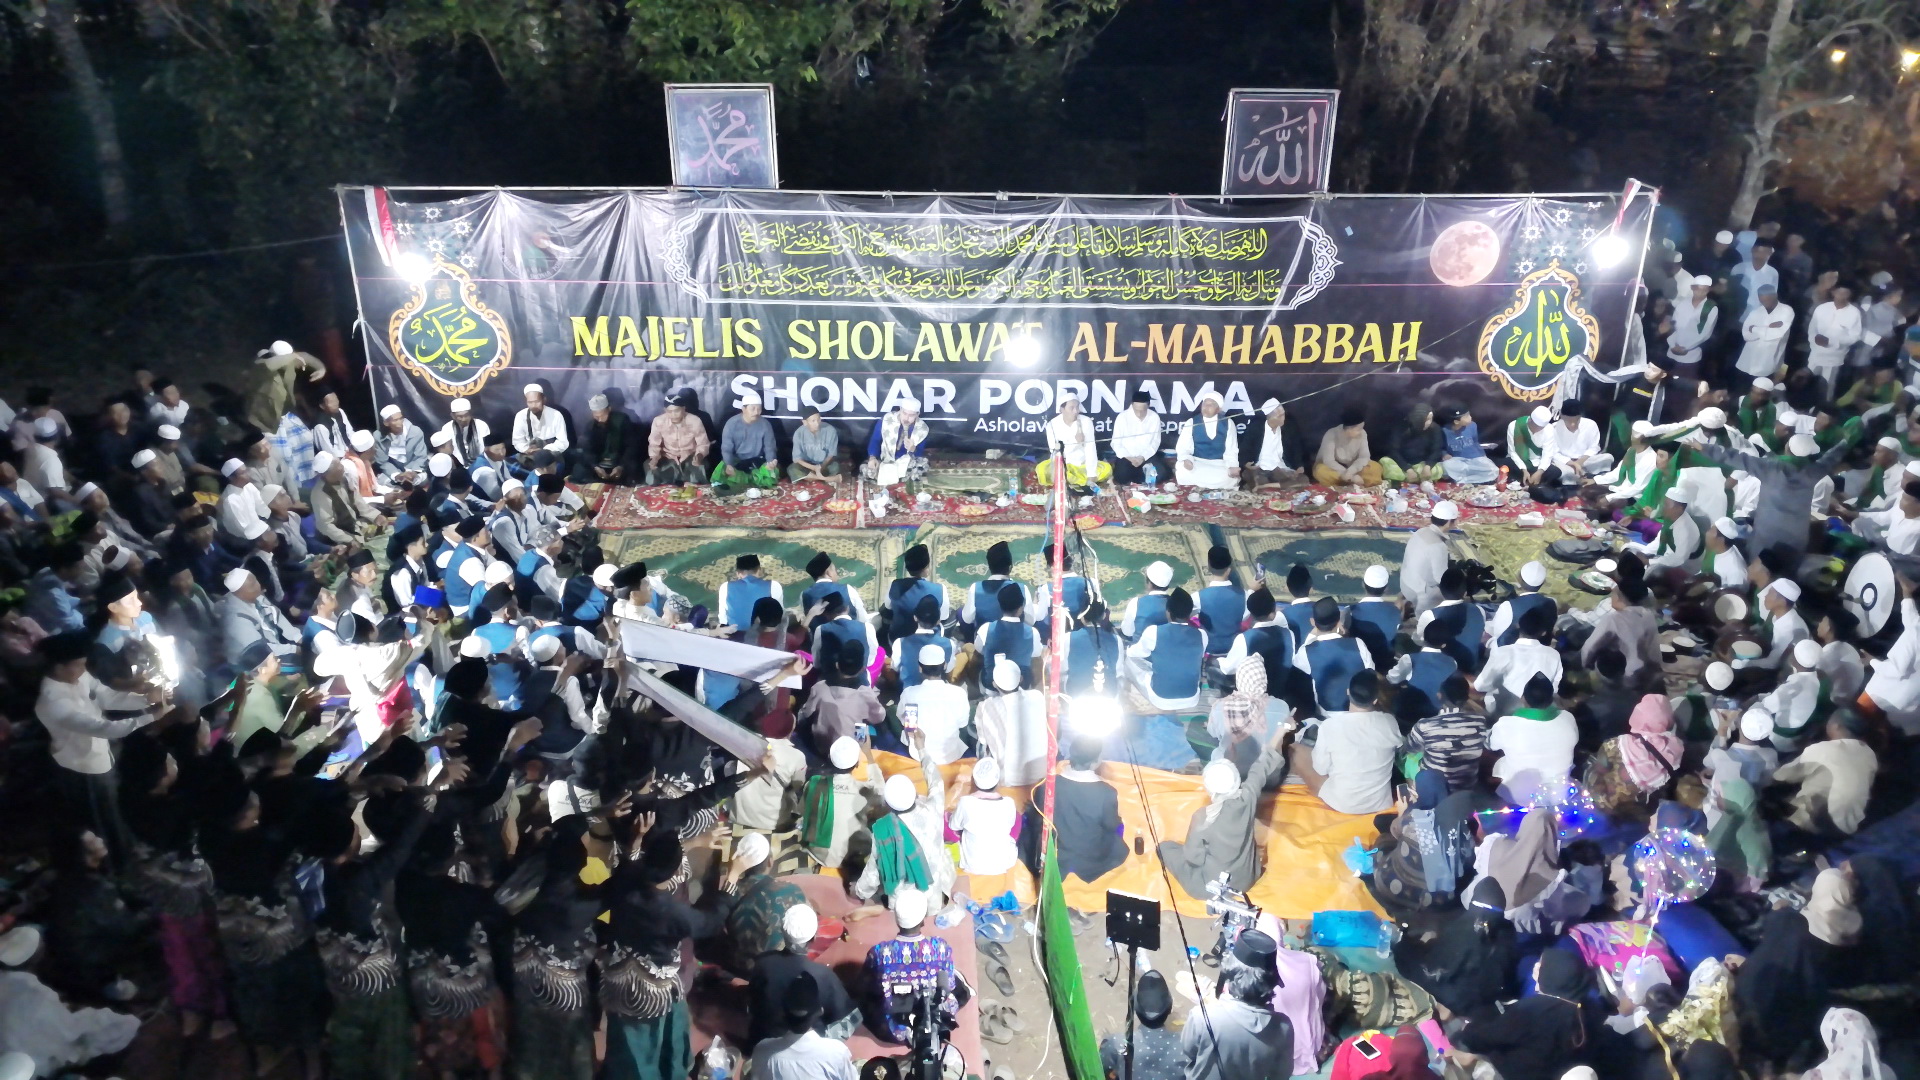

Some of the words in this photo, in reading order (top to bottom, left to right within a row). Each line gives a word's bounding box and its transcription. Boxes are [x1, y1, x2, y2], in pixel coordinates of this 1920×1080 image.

[572, 315, 763, 362] MAJELIS
[788, 319, 1043, 364] SHOLAWAT
[1066, 321, 1422, 365] AL-MAHABBAH
[731, 373, 956, 414] SHONAR
[979, 378, 1256, 417] PORNAMA
[973, 416, 1048, 433] Asholaw
